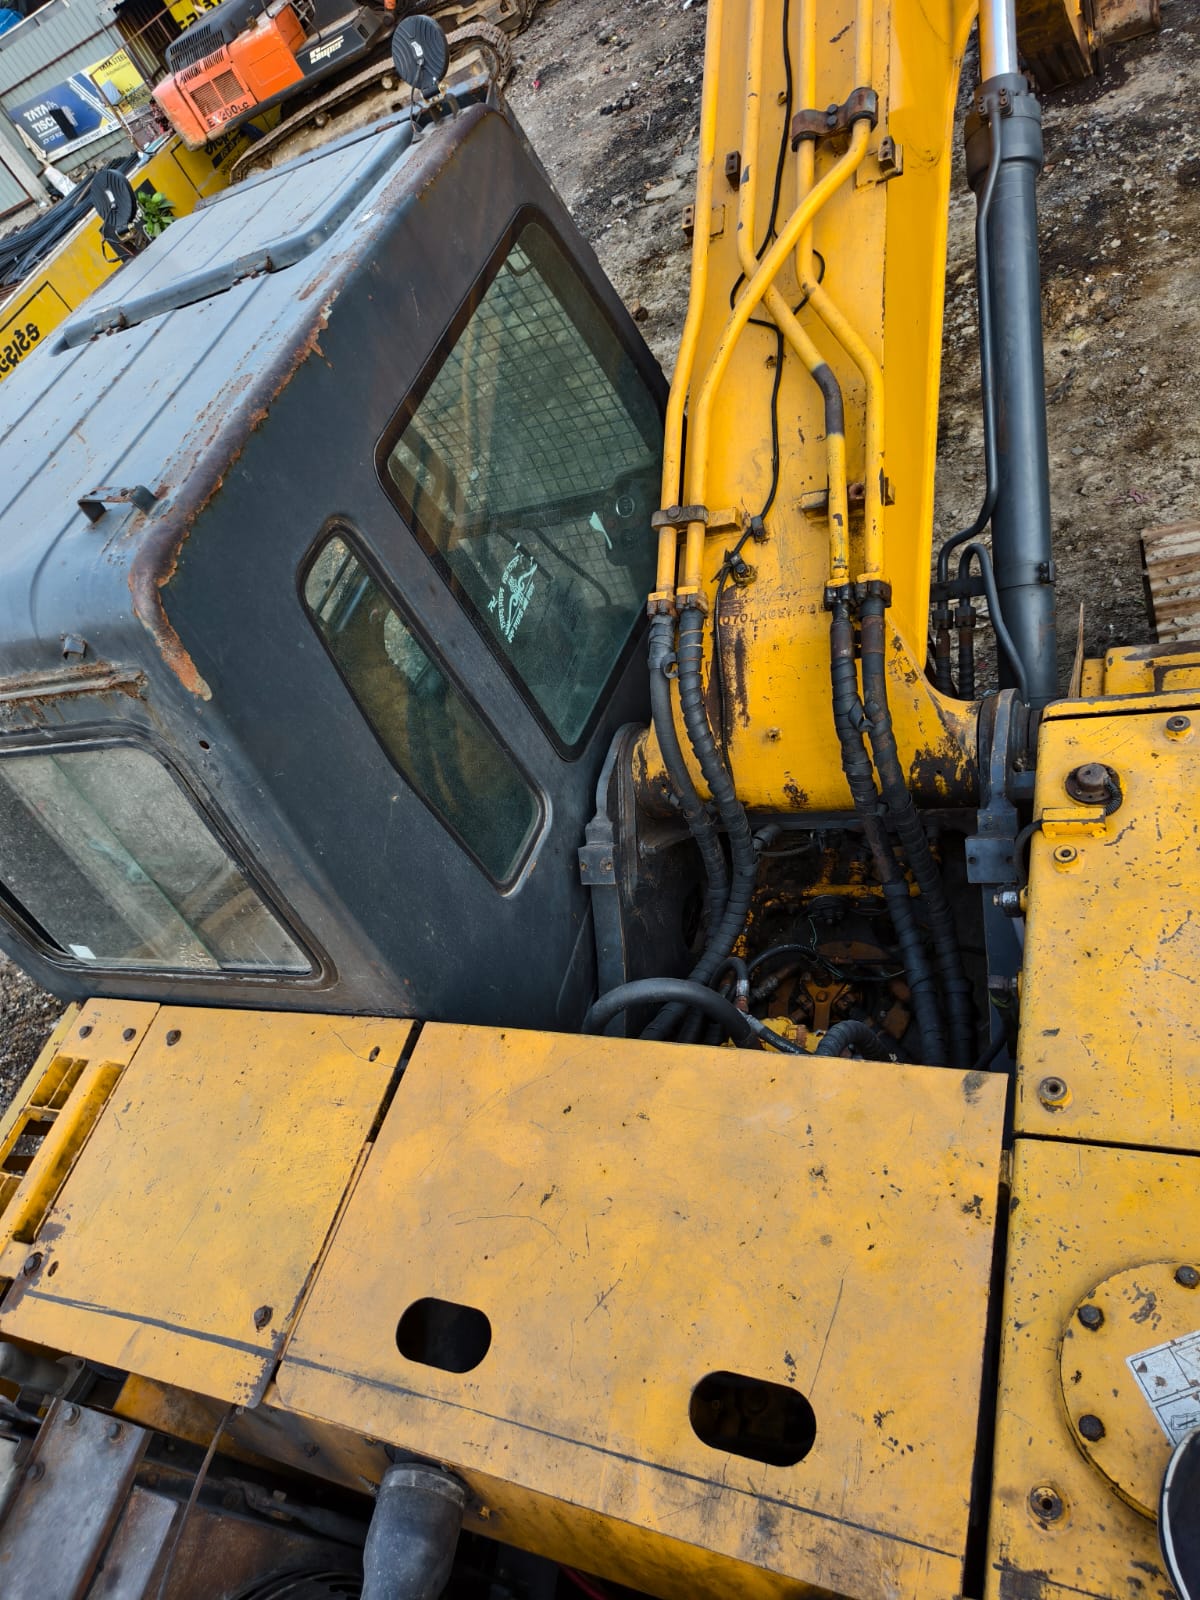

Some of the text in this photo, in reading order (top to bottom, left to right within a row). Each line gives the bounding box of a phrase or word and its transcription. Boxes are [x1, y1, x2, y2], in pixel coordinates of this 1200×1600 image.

[310, 36, 345, 64] Super
[23, 104, 49, 122] TATA
[31, 116, 57, 133] TISC
